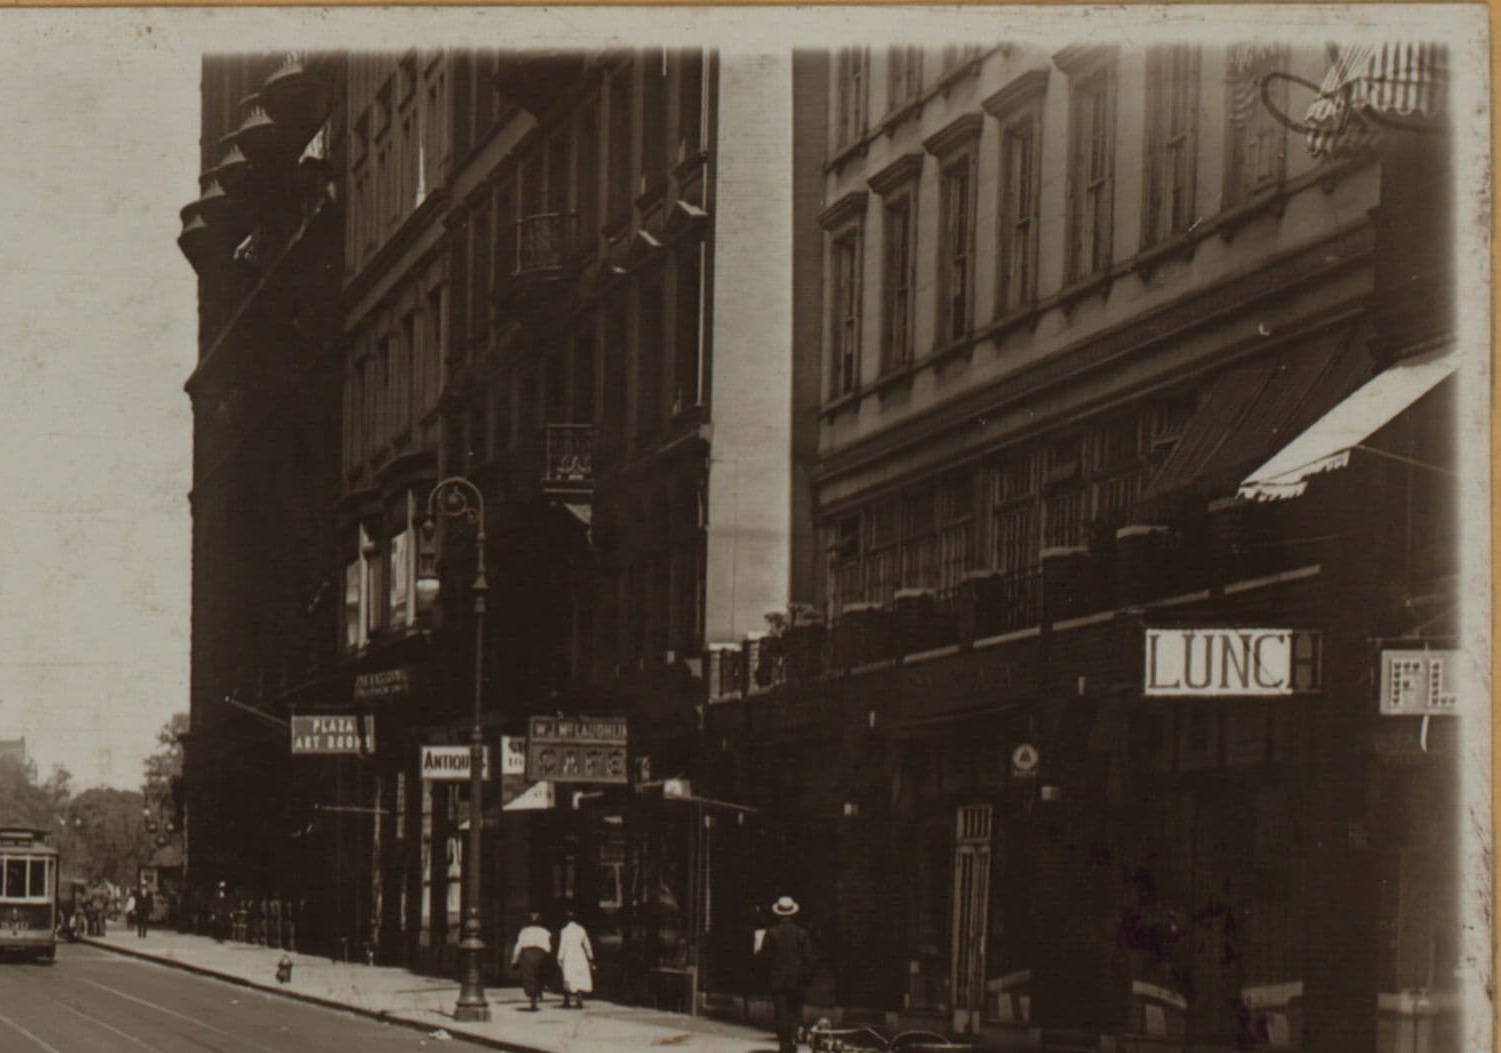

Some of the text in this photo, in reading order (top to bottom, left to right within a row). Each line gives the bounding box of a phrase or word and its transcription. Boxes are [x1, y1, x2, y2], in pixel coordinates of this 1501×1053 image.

[1147, 633, 1323, 690] LUNCH
[312, 719, 354, 733] PLAZA
[424, 751, 486, 770] ANTIQU
